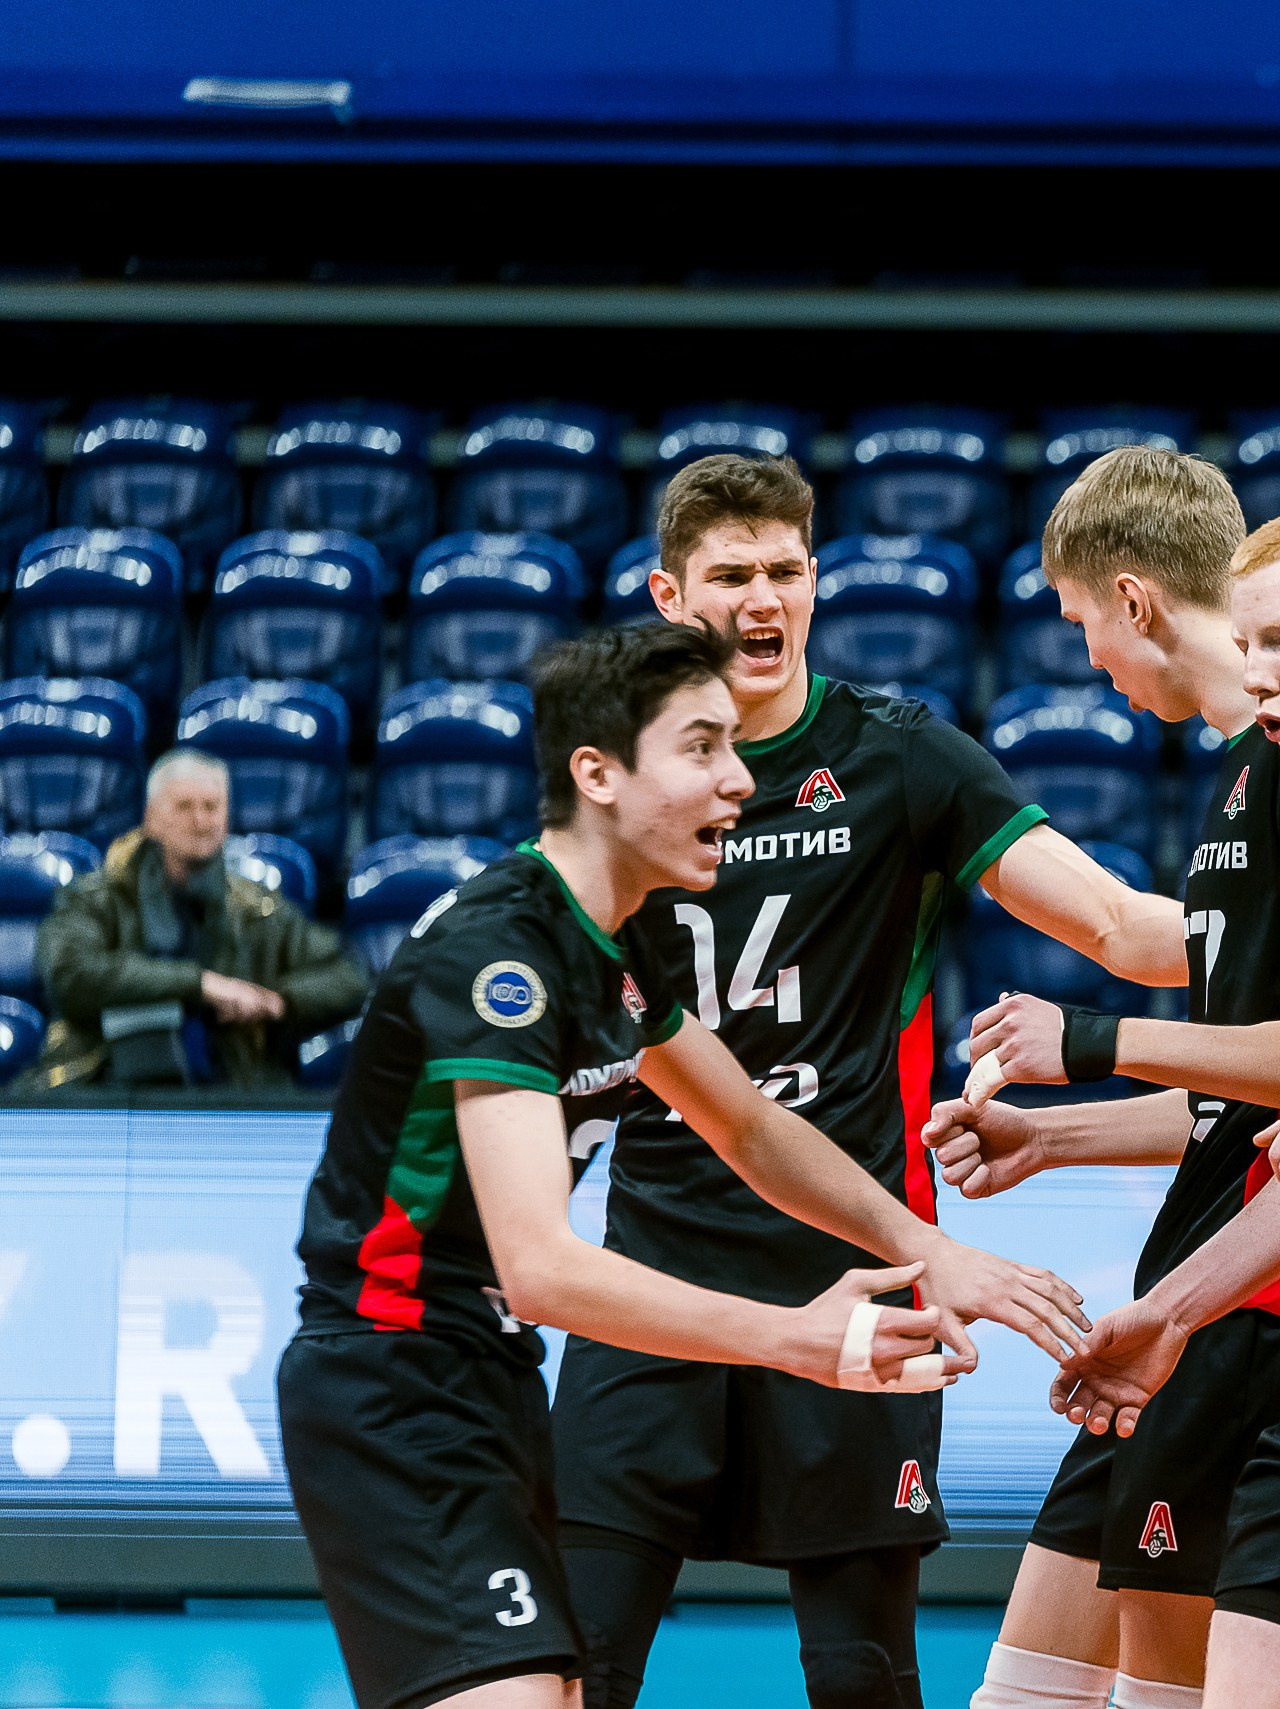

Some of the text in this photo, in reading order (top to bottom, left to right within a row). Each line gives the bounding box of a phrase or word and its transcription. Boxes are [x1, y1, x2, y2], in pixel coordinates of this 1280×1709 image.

[722, 827, 851, 864] МОТИВ
[674, 894, 801, 1030] 14
[487, 1567, 538, 1627] 3
